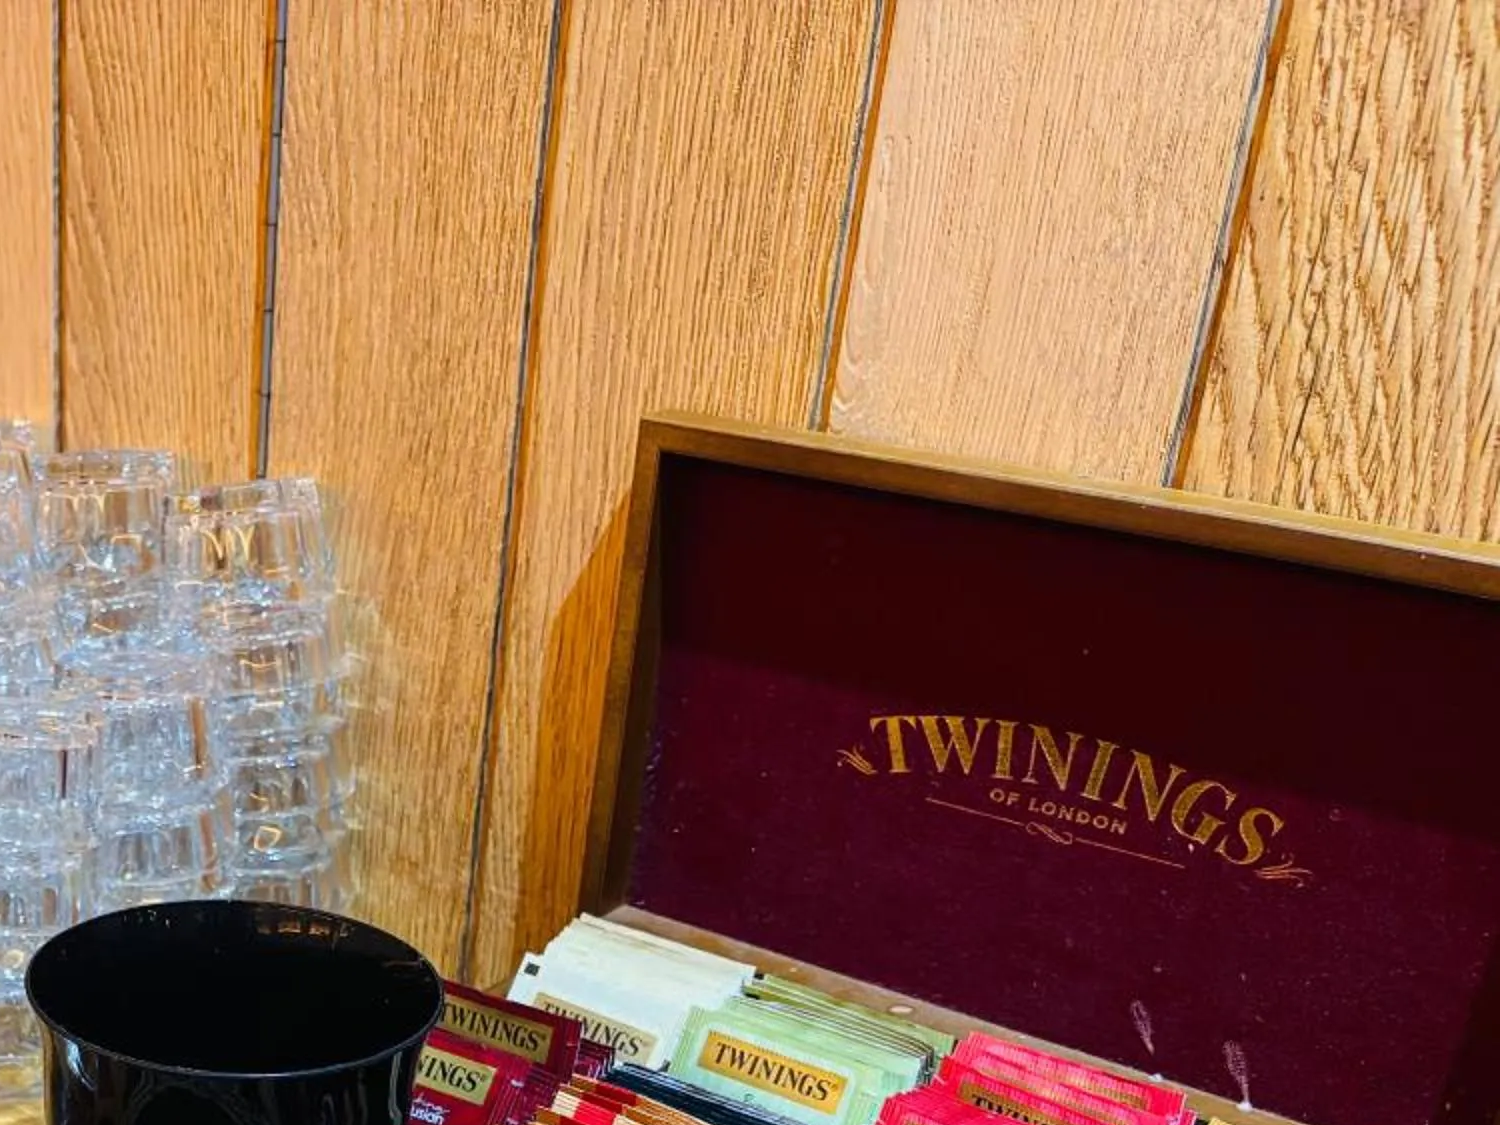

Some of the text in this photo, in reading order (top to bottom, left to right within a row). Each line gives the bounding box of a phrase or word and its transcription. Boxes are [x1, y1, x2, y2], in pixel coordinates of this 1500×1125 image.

[869, 714, 1285, 867] TWININGS
[988, 788, 1129, 836] OF LONDON
[715, 1041, 832, 1102] TWININGS
